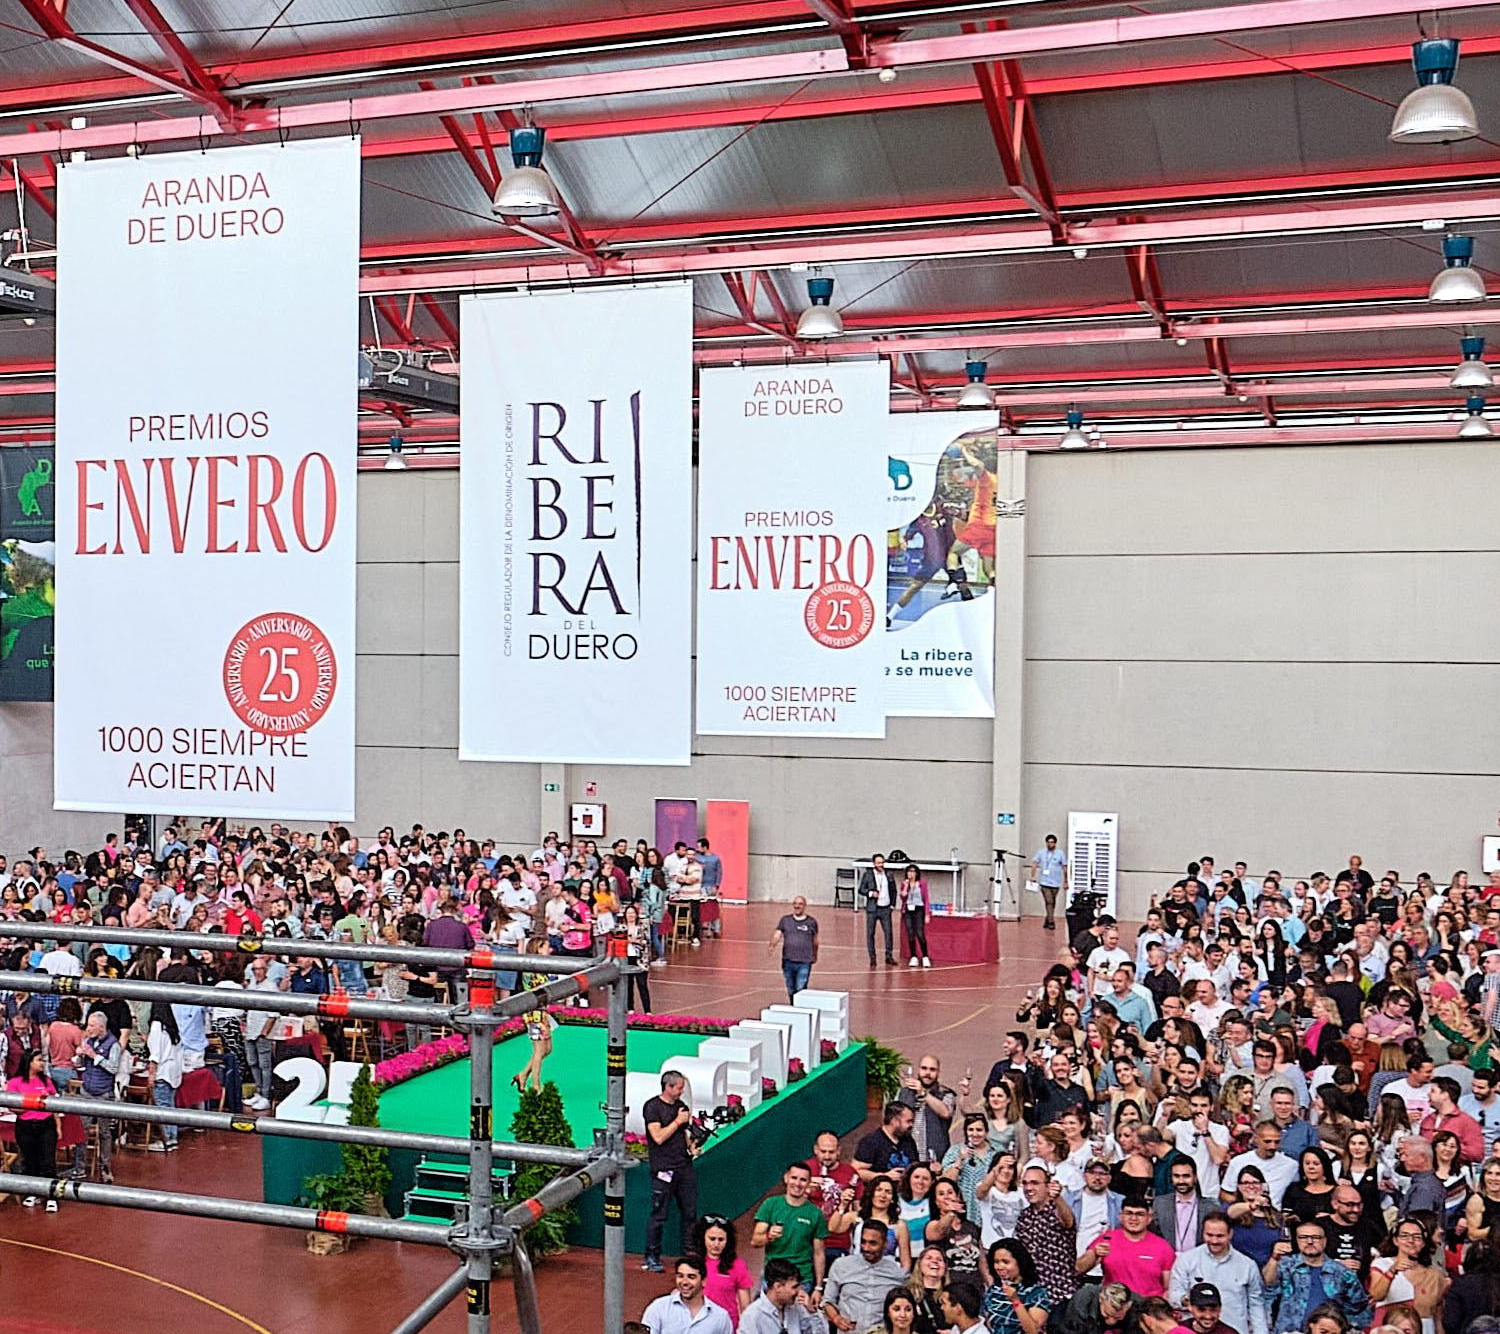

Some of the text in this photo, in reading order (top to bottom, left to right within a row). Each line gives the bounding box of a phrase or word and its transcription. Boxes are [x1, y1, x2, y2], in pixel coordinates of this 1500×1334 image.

[142, 171, 271, 210] ARANDA
[127, 207, 286, 246] DE DUERO
[753, 378, 834, 397] ARANDA
[744, 398, 844, 417] DE DUERO
[128, 411, 270, 444] PREMIOS
[74, 451, 338, 557] ENVERO
[744, 510, 834, 529] PREMIOS
[710, 533, 875, 592] ENVERO
[563, 619, 597, 631] DEL
[826, 599, 852, 630] 25
[248, 617, 312, 641] ANIVERSARIO
[528, 633, 639, 661] DUERO
[901, 649, 973, 661] La ribera
[25, 660, 49, 670] que
[259, 646, 300, 702] 25
[896, 666, 914, 676] se
[919, 666, 974, 677] mueve
[723, 685, 857, 703] 1000 SIEMPRE
[743, 705, 836, 723] ACIERTAN
[97, 725, 309, 759] 1000 SIEMPRE
[127, 761, 276, 794] ACIERTAN
